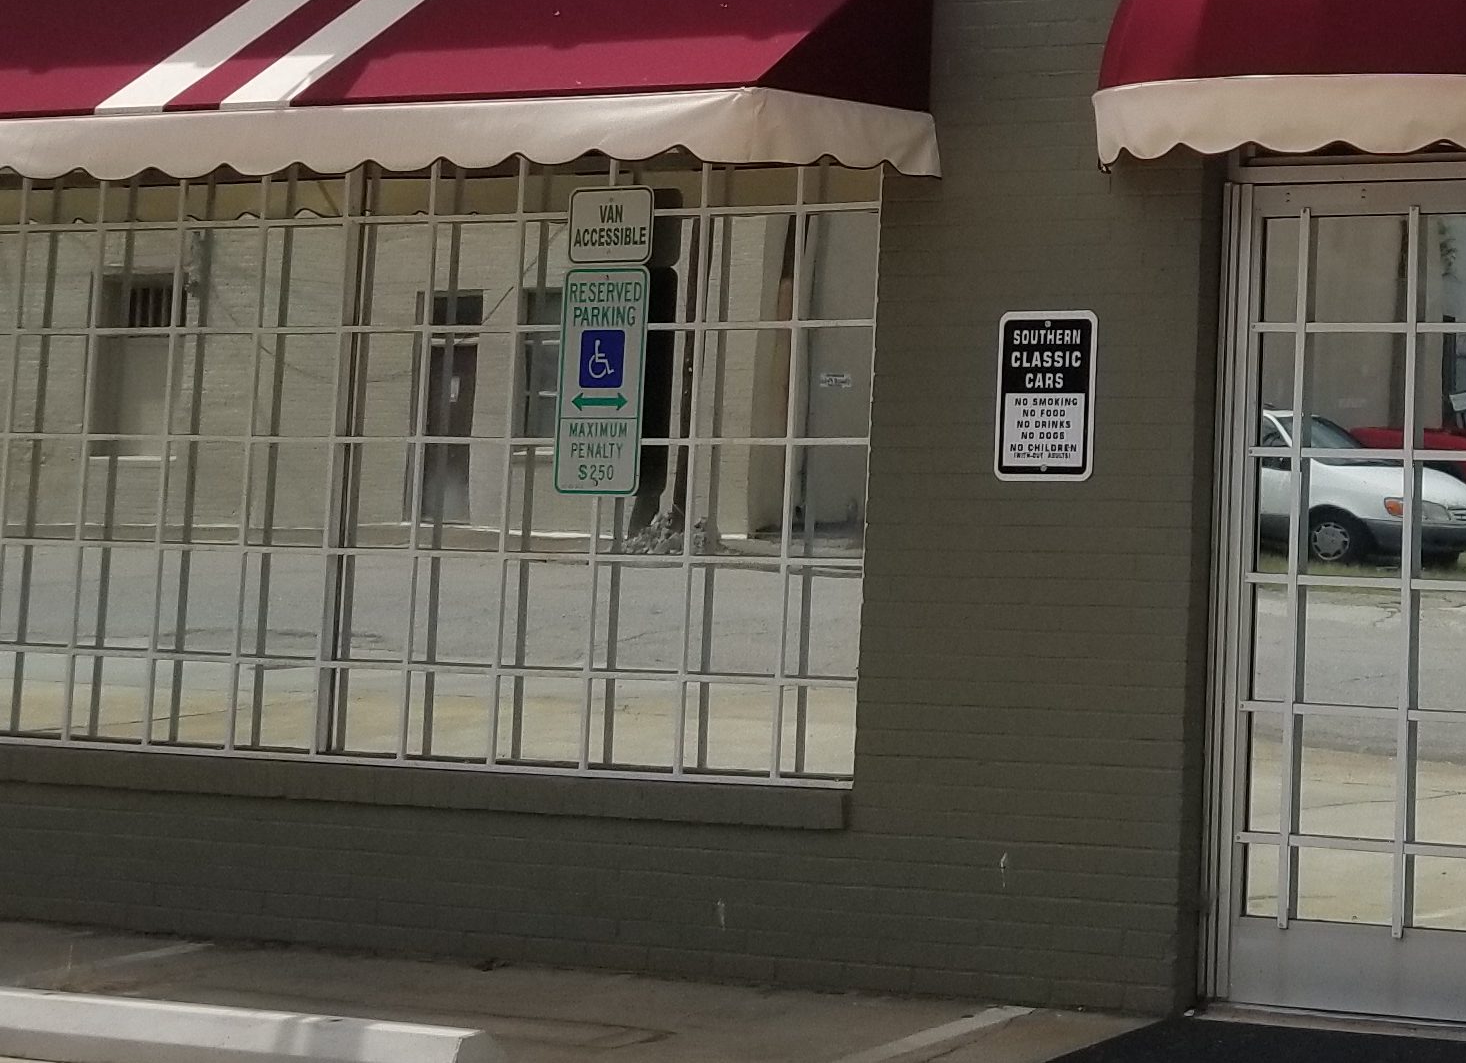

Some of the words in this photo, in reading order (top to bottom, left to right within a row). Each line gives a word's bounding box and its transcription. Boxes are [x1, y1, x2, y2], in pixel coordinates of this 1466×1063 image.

[599, 204, 623, 224] VAN
[573, 226, 647, 248] ACCESSIBLE
[568, 281, 643, 304] RESERVED
[572, 305, 637, 328] PARKING
[1013, 329, 1081, 345] SOUTHERN
[1011, 350, 1082, 368] CLASSIC
[1025, 372, 1064, 389] CARS
[1015, 397, 1028, 406] NO
[1032, 397, 1078, 406] SMOKING
[1022, 409, 1036, 417] NO
[1040, 409, 1066, 417] FOOD
[568, 422, 628, 438] MAXIMUM
[1016, 420, 1030, 428] NO
[1034, 420, 1071, 428] DRINKS
[1021, 431, 1035, 439] NO
[1039, 431, 1065, 439] DOGS
[570, 442, 624, 459] PENALTY
[1010, 443, 1024, 452] NO
[1027, 443, 1077, 452] CHILDREN
